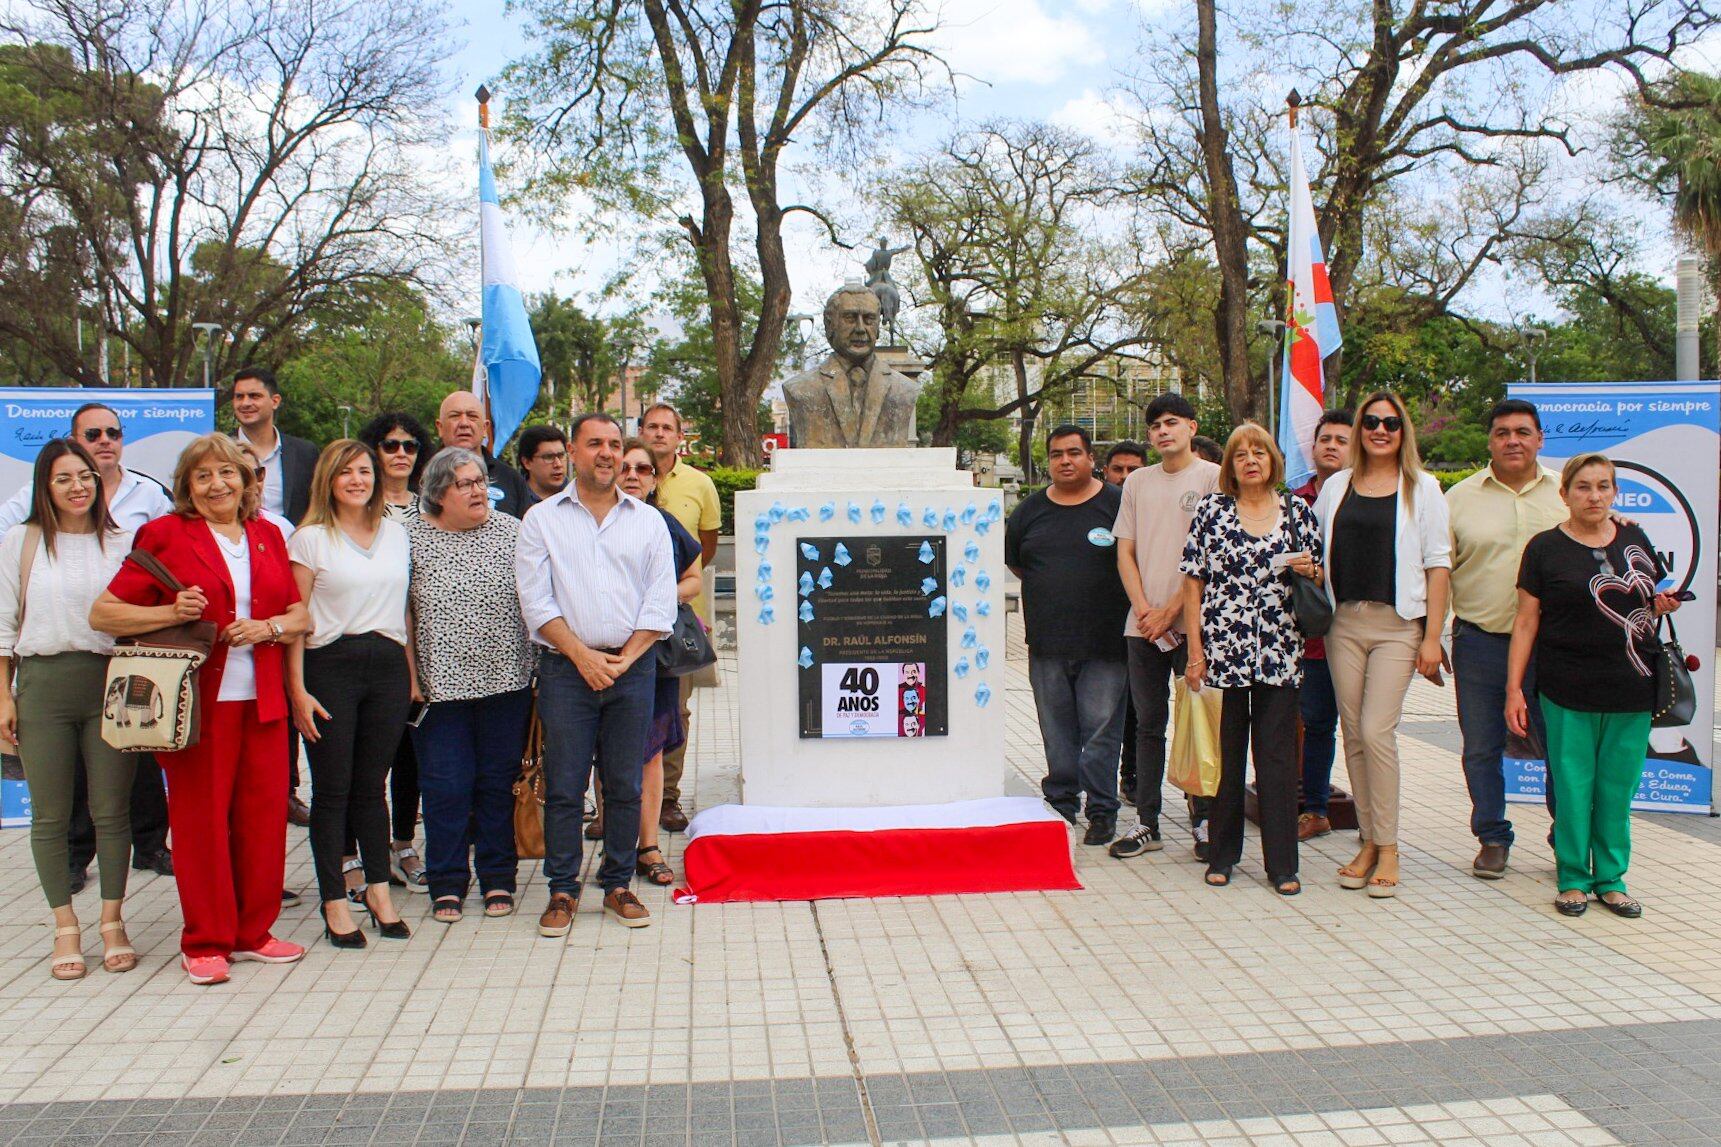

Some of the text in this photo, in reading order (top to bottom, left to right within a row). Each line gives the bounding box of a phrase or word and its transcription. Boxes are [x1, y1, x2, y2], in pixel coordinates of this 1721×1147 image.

[5, 404, 76, 418] Democr
[143, 406, 206, 422] siempre
[1534, 400, 1712, 416] emocracia por siempre
[823, 633, 927, 646] DR. RAÚL ALFONSÍN
[839, 667, 879, 695] 40
[1658, 769, 1696, 782] Come,
